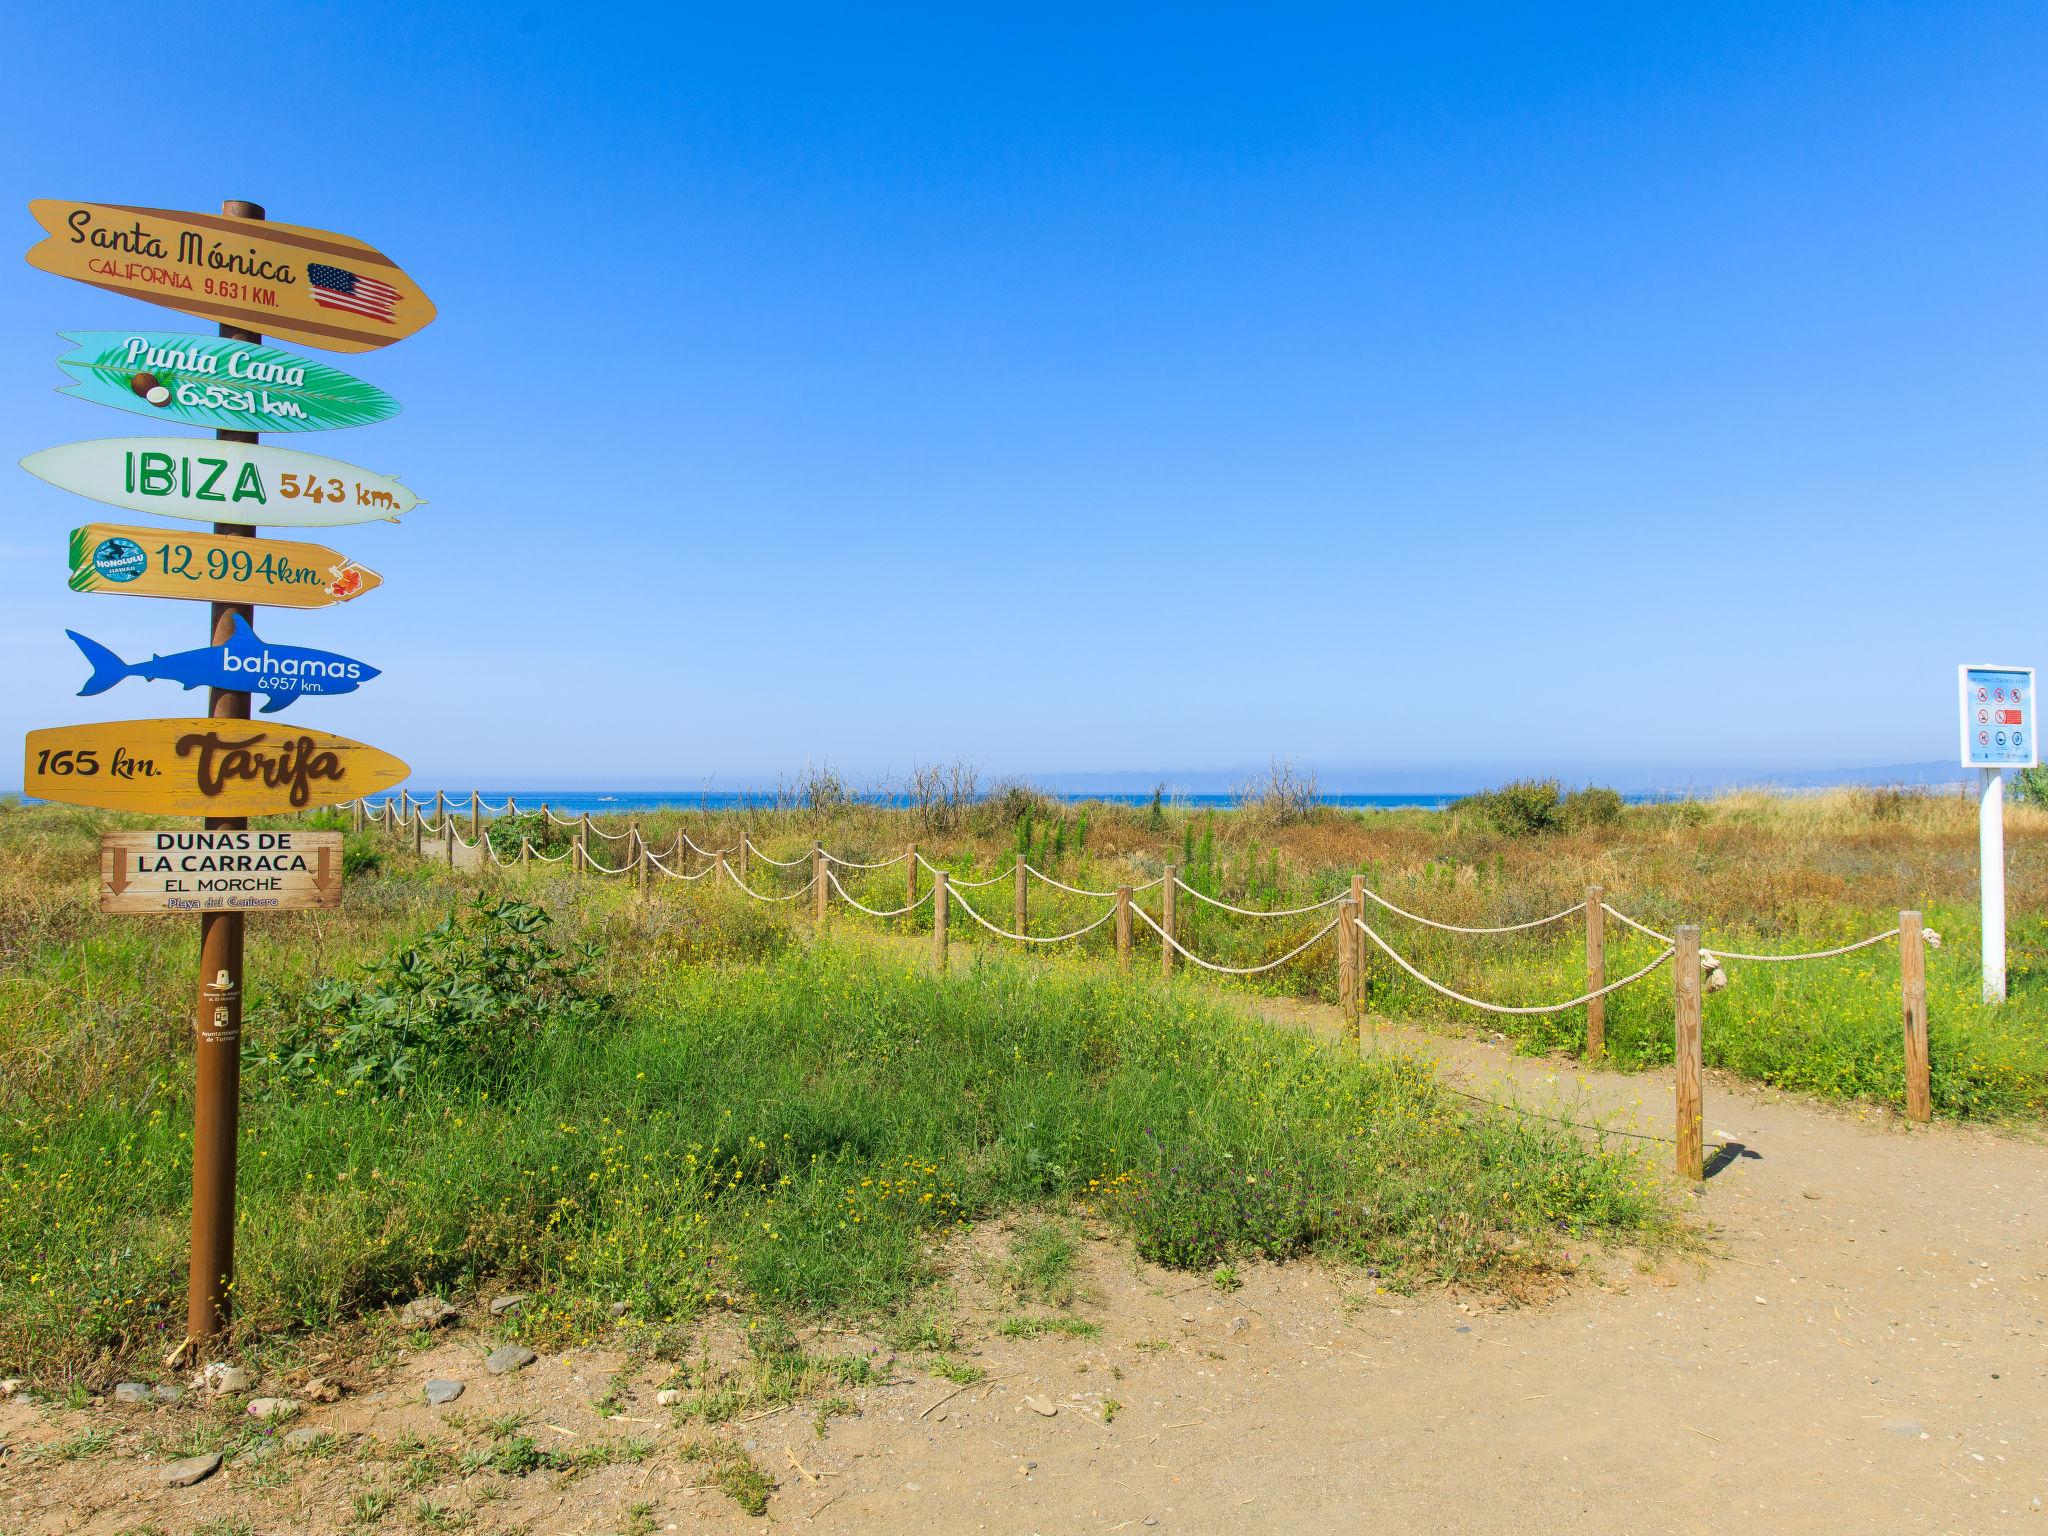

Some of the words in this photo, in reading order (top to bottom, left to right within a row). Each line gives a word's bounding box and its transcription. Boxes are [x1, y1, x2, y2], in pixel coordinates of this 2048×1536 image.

[68, 210, 168, 258] Santa
[177, 231, 296, 284] Mónica
[88, 258, 193, 291] CALIFORNIA
[204, 278, 248, 301] 9.631
[252, 287, 280, 308] KM.
[123, 336, 218, 375] Punta
[228, 351, 305, 387] Cana
[176, 383, 256, 414] 6.531
[262, 390, 308, 420] km.
[125, 451, 267, 505] IBIZA
[279, 473, 346, 504] 543
[355, 482, 401, 510] km.
[96, 554, 144, 568] HONOLULU
[223, 647, 361, 679] bahamas
[258, 676, 298, 691] 6.957
[301, 679, 324, 692] km.
[38, 749, 99, 776] 165
[110, 747, 162, 780] km.
[176, 732, 346, 807] Tarifa
[157, 833, 250, 850] DUNAS
[258, 833, 291, 850] DE
[138, 855, 173, 873] LA
[181, 855, 308, 872] CARRACA
[165, 880, 190, 892] EL
[197, 878, 282, 892] MORCHE
[168, 897, 201, 911] Playa
[204, 896, 224, 908] del
